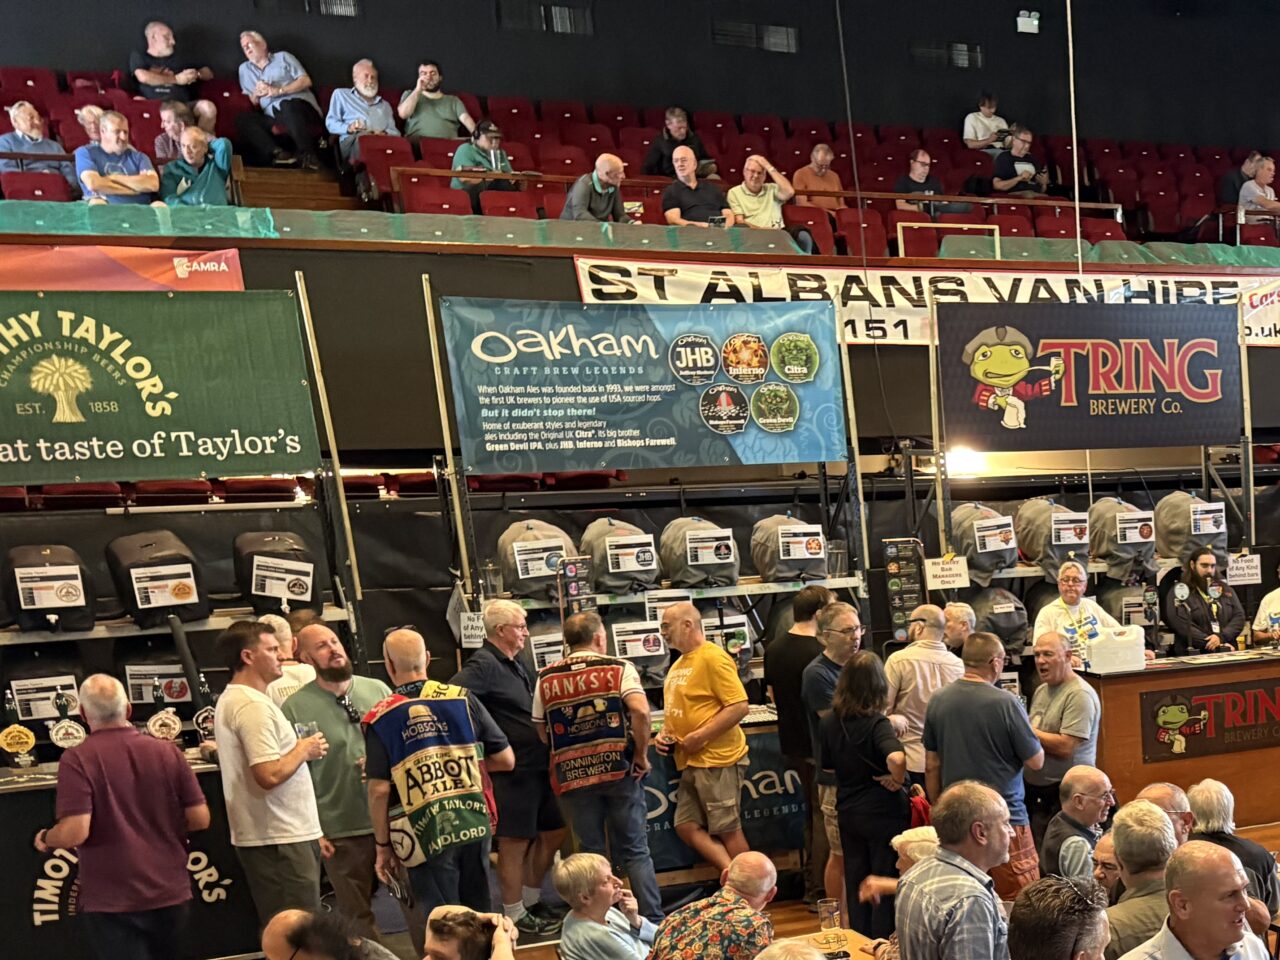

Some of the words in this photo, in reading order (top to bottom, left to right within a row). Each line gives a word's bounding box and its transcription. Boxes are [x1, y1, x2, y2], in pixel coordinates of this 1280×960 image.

[183, 262, 229, 273] CAMRA
[587, 265, 677, 301] ST
[700, 270, 968, 309] ALBANS
[982, 276, 1098, 303] VAN
[470, 324, 660, 363] Oakham
[0, 341, 88, 388] CHAMPIONSHIP
[57, 310, 179, 418] TAYLOR'S
[675, 347, 715, 368] JHB
[92, 353, 127, 386] BEERS
[494, 366, 538, 375] CRAFT
[544, 366, 579, 375] BREW
[585, 366, 644, 375] LEGENDS
[729, 366, 765, 375] Inferno
[784, 365, 808, 374] Citra
[1036, 337, 1222, 406] TRING
[477, 385, 497, 393] When
[499, 385, 525, 393] Oakham
[526, 385, 540, 393] Ales
[555, 384, 581, 393] founded
[582, 384, 597, 393] back
[606, 384, 623, 393] 1993,
[651, 384, 675, 392] amongst
[15, 402, 46, 414] EST.
[88, 401, 119, 413] 1858
[479, 396, 490, 404] the
[506, 396, 515, 404] UK
[517, 396, 542, 404] brewers
[552, 395, 575, 405] pioneer
[577, 395, 587, 403] the
[609, 395, 621, 403] USA
[1089, 398, 1156, 416] BREWERY
[1161, 398, 1183, 414] Co.
[481, 409, 499, 417] But
[501, 408, 509, 417] it
[512, 408, 540, 417] didn't
[542, 408, 564, 417] stop
[567, 407, 596, 416] there!
[483, 422, 502, 430] Home
[512, 421, 543, 429] exuberant
[545, 421, 563, 430] styles
[565, 421, 576, 429] and
[578, 420, 607, 429] legendary
[499, 432, 527, 441] including
[541, 431, 563, 440] Original
[607, 430, 616, 438] big
[618, 429, 640, 437] brother
[36, 437, 124, 462] taste
[132, 431, 166, 458] of
[171, 427, 302, 461] Taylor's
[486, 443, 509, 451] Green
[510, 443, 528, 451] Devil
[546, 441, 559, 450] plus
[576, 440, 603, 448] Inferno
[617, 439, 644, 448] Bishops
[542, 670, 615, 699] BANKS'S
[1224, 727, 1269, 744] BREWERY
[561, 751, 621, 773] DONNINGTON
[566, 762, 613, 780] BREWERY
[405, 755, 474, 806] ABBOT
[430, 779, 465, 795] ALE
[33, 848, 79, 926] TIMOT
